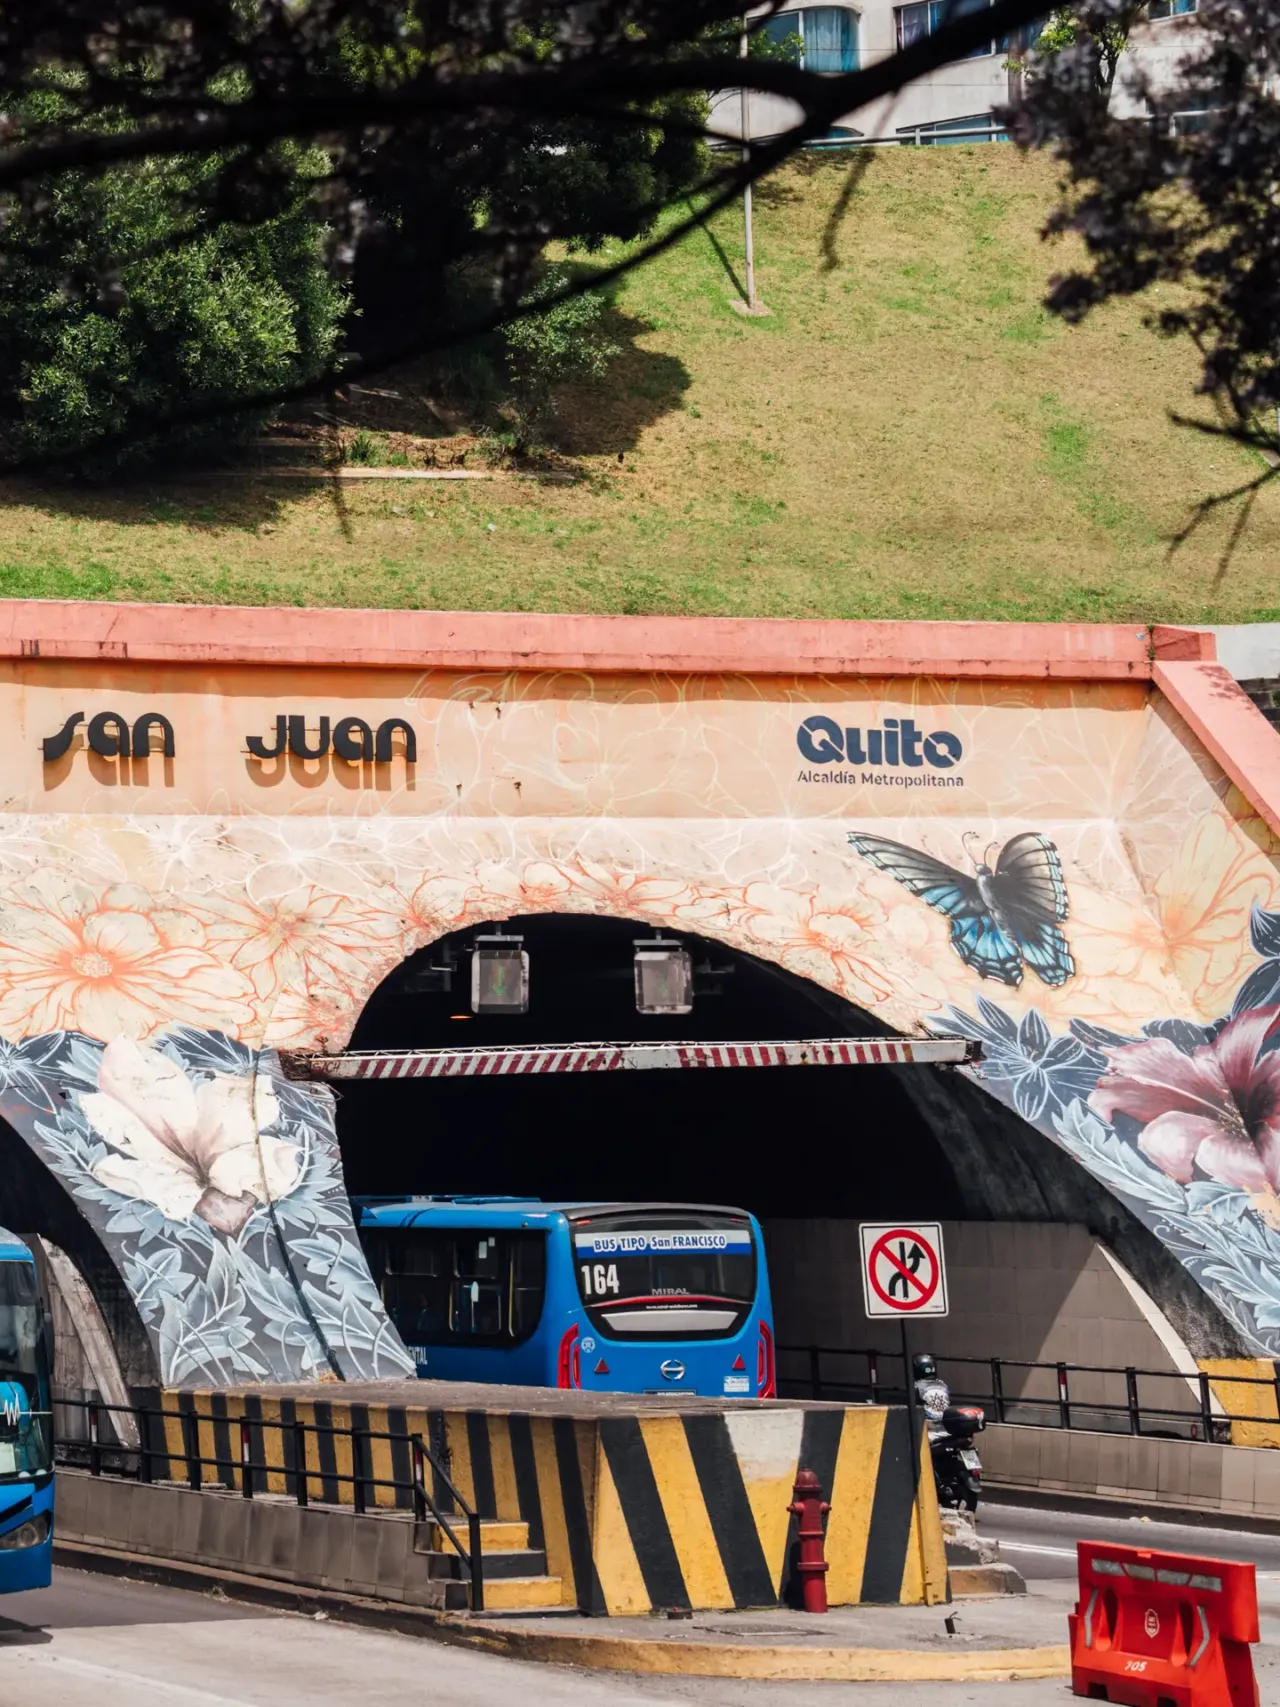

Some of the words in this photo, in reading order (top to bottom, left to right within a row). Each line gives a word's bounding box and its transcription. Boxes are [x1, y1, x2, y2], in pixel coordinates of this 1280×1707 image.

[42, 711, 176, 762] san
[797, 715, 963, 768] Quito
[798, 770, 856, 785] Alcaldía
[861, 772, 964, 789] Metropolitana
[594, 1238, 616, 1250] BUS
[620, 1236, 645, 1249] TIPO
[652, 1236, 670, 1247] San
[672, 1236, 726, 1248] FRANCISCO
[581, 1264, 619, 1294] 164
[651, 1287, 691, 1296] MIRAL
